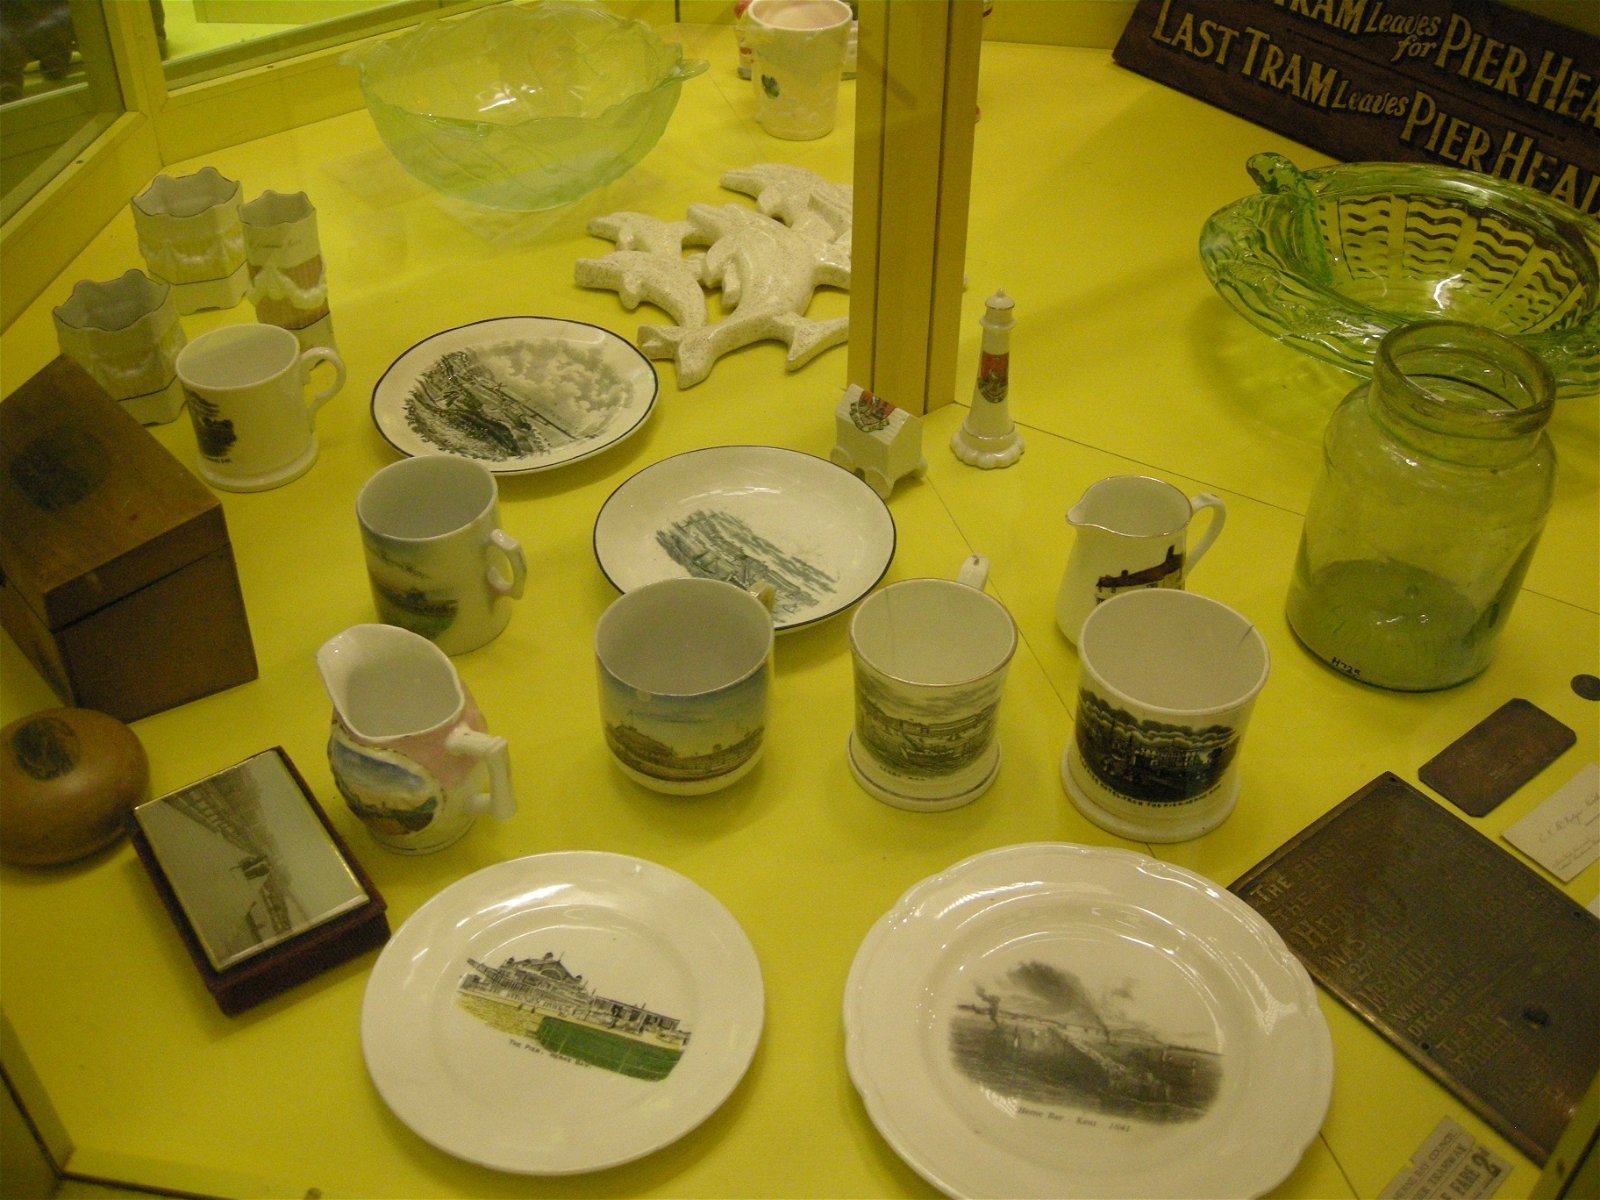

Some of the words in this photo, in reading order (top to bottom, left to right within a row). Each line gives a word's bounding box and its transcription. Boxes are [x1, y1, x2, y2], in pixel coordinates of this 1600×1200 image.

[1364, 2, 1442, 37] Leaves
[1390, 35, 1437, 62] for
[1434, 13, 1528, 97] PIER
[1151, 0, 1240, 66] LAST
[1241, 26, 1338, 109] TRAM
[1331, 79, 1410, 118] Leaves
[1399, 90, 1491, 174] PIER
[1075, 1116, 1097, 1127] Kent
[1428, 1129, 1457, 1161] COUNCIL
[1428, 1143, 1466, 1185] TRAMWAY
[1449, 1164, 1480, 1196] FARE
